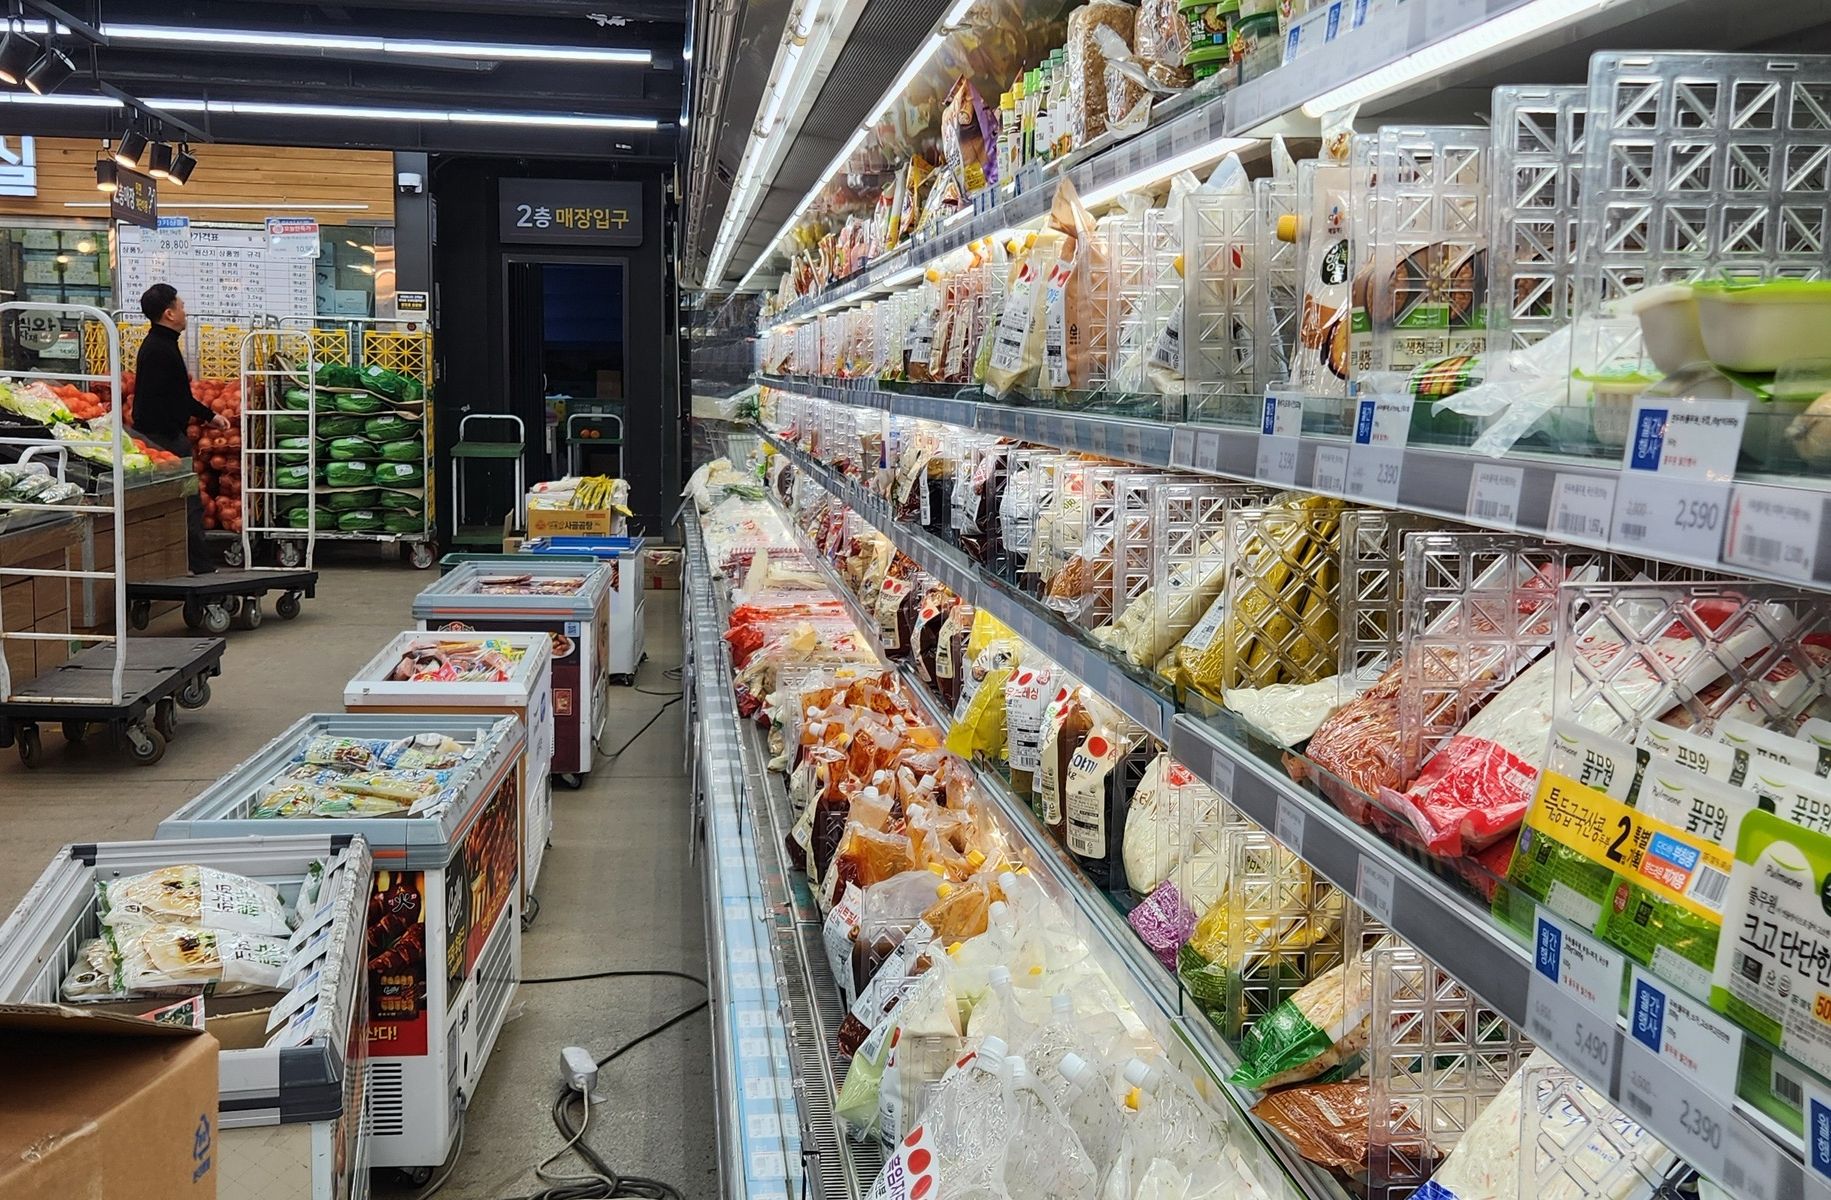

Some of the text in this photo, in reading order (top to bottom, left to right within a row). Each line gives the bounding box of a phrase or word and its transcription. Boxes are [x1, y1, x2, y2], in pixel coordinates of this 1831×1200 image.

[516, 204, 629, 230] 2층 매장입구
[161, 240, 189, 250] 28,800
[1674, 499, 1719, 531] 2,590
[1580, 749, 1615, 787] 풀무원
[1606, 815, 1632, 863] 2
[1575, 1023, 1608, 1066] 5,490
[1679, 1099, 1721, 1149] 2,390
